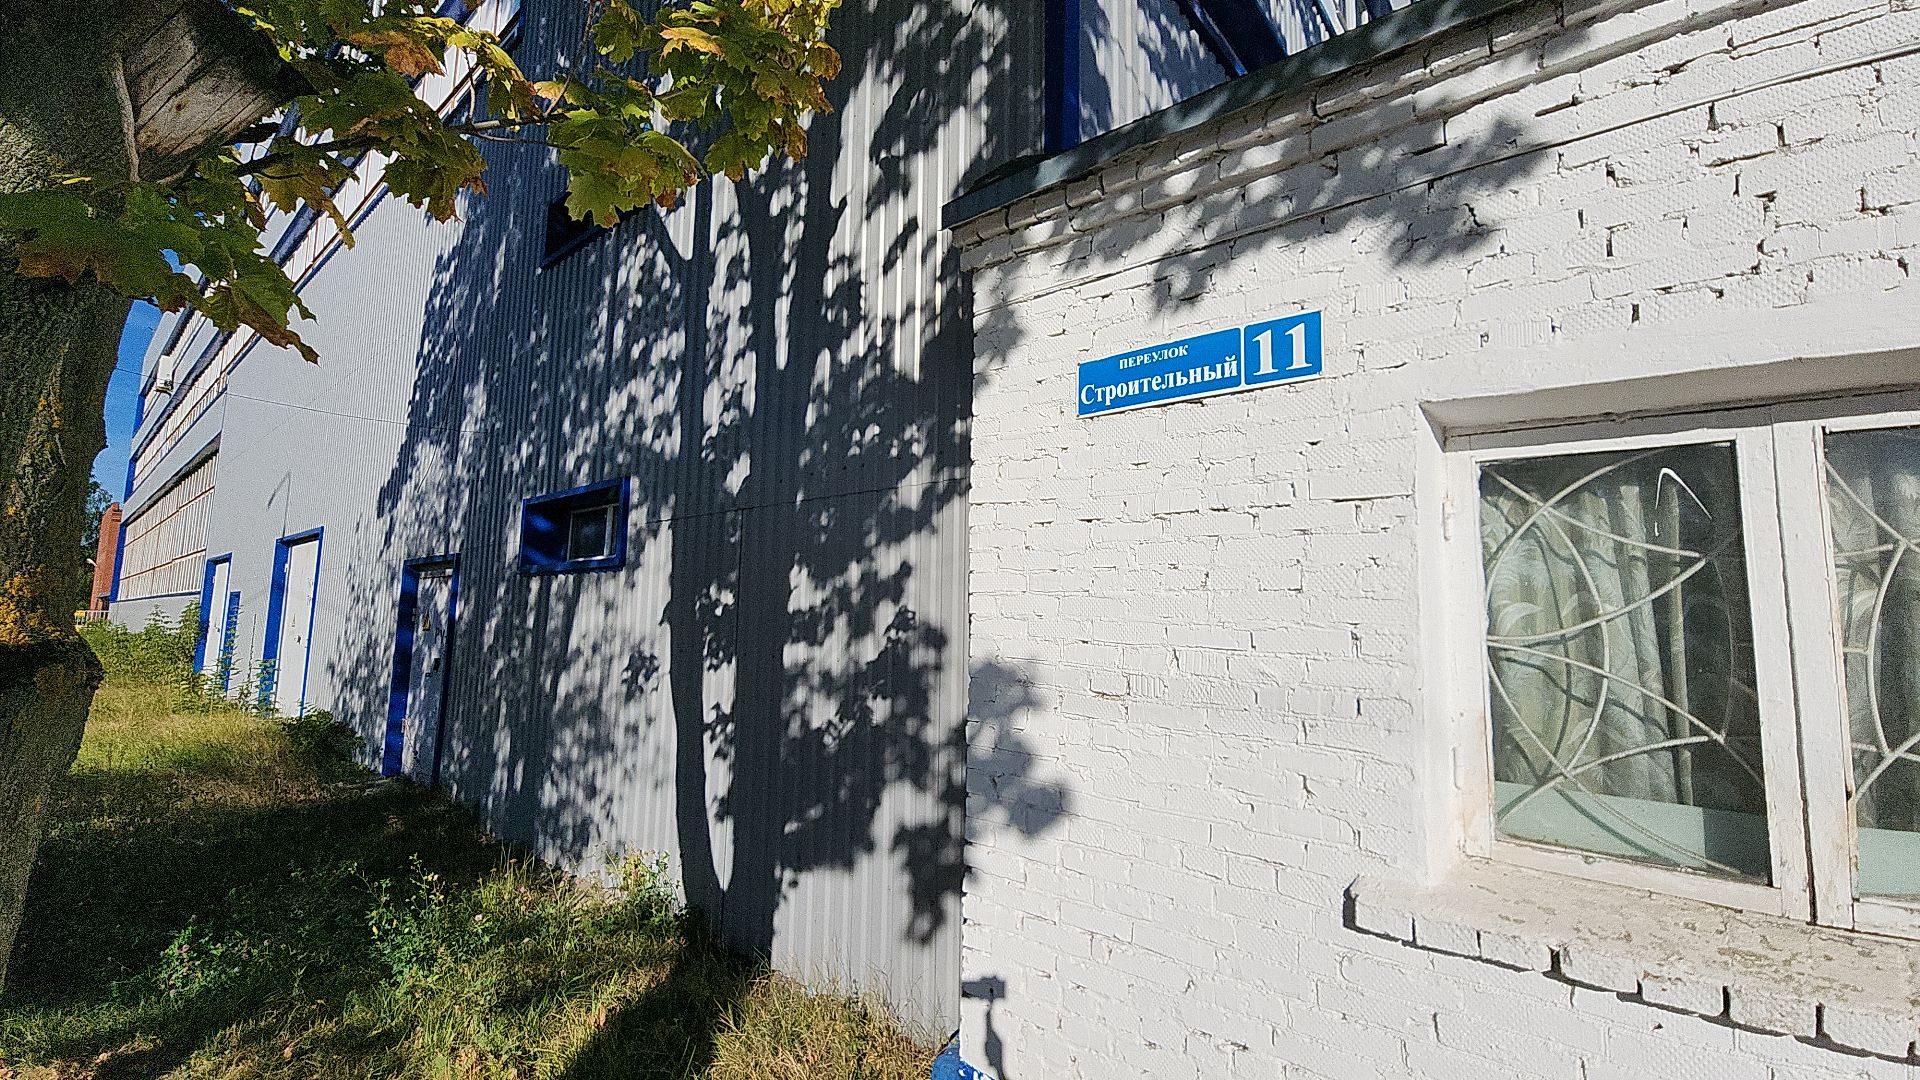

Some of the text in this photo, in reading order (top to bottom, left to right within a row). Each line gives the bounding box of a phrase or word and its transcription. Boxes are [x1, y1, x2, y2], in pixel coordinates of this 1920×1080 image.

[1119, 345, 1188, 369] ПЕРЕУЛОК
[1252, 322, 1312, 376] 11
[1081, 355, 1238, 405] Строительный
